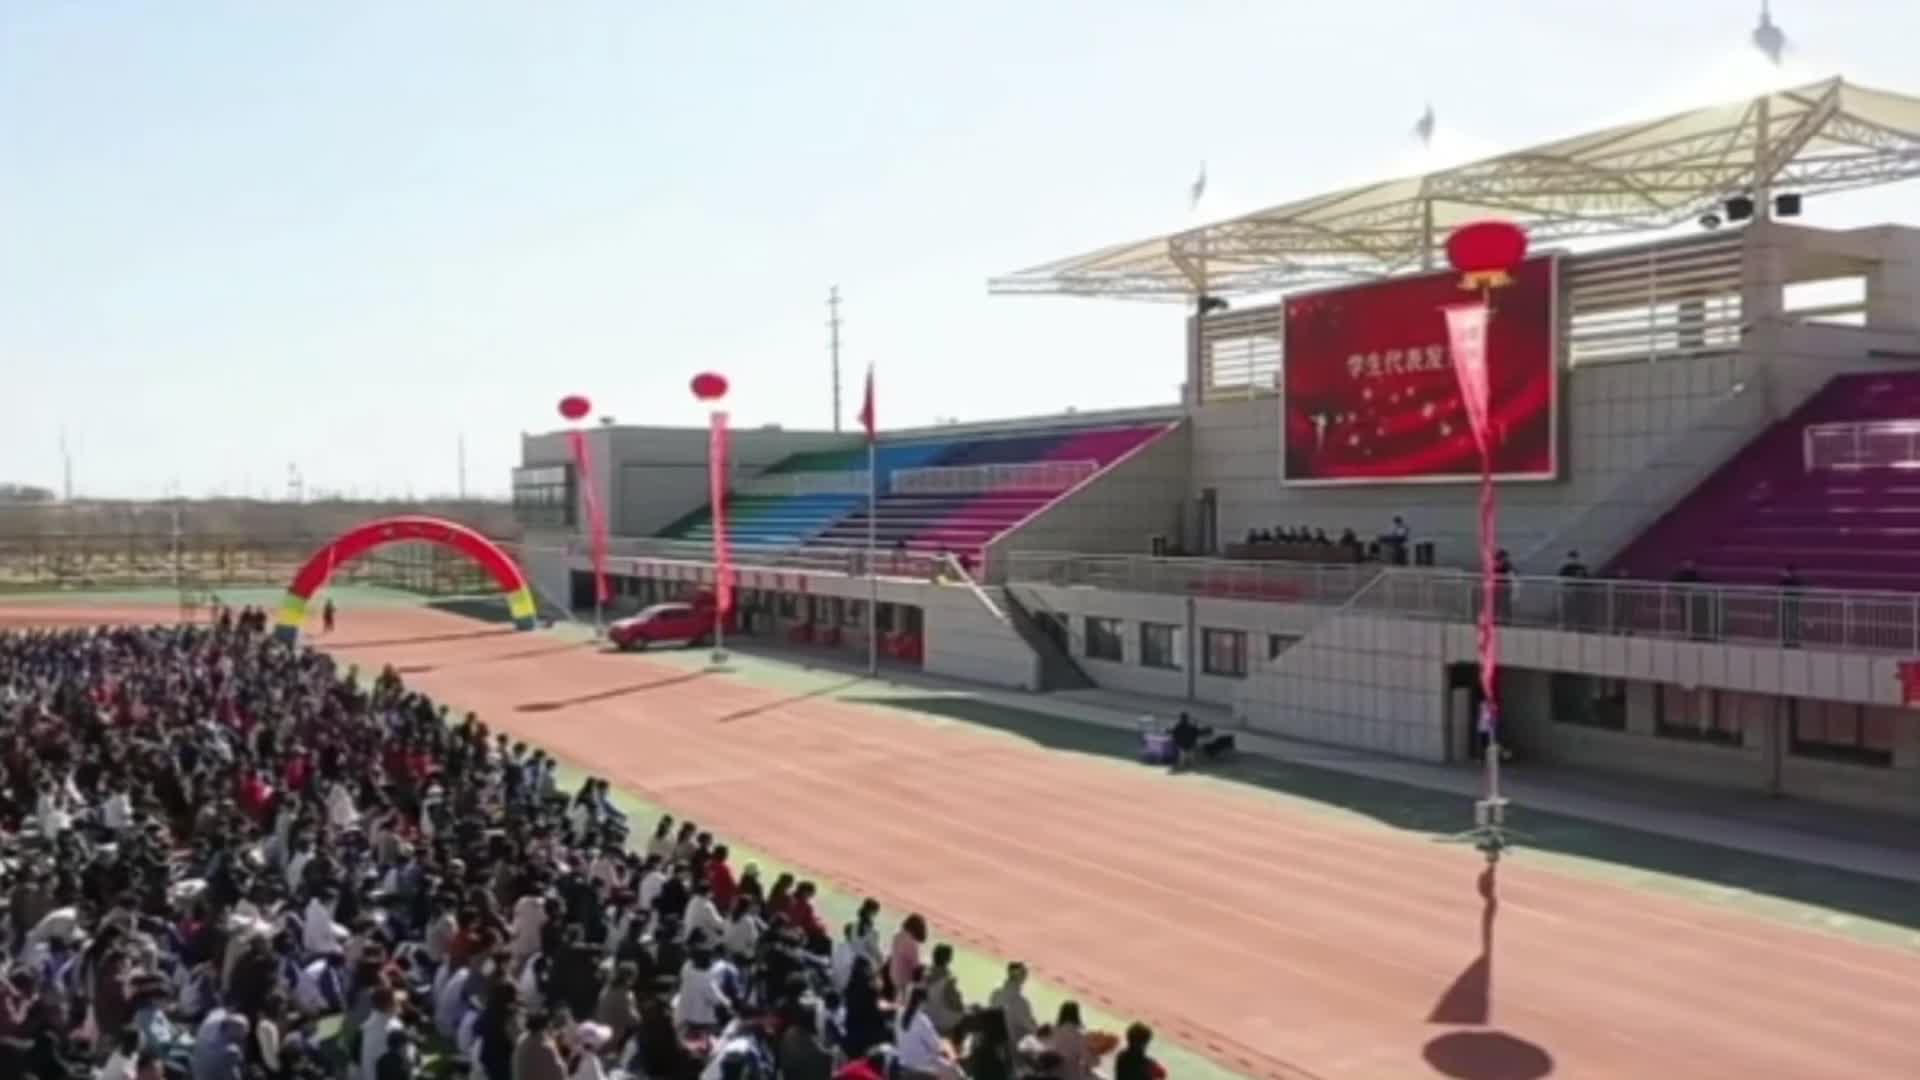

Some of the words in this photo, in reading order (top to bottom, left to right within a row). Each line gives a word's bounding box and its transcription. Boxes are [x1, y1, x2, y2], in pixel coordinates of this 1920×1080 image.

[1346, 345, 1453, 379] 学生代表发
